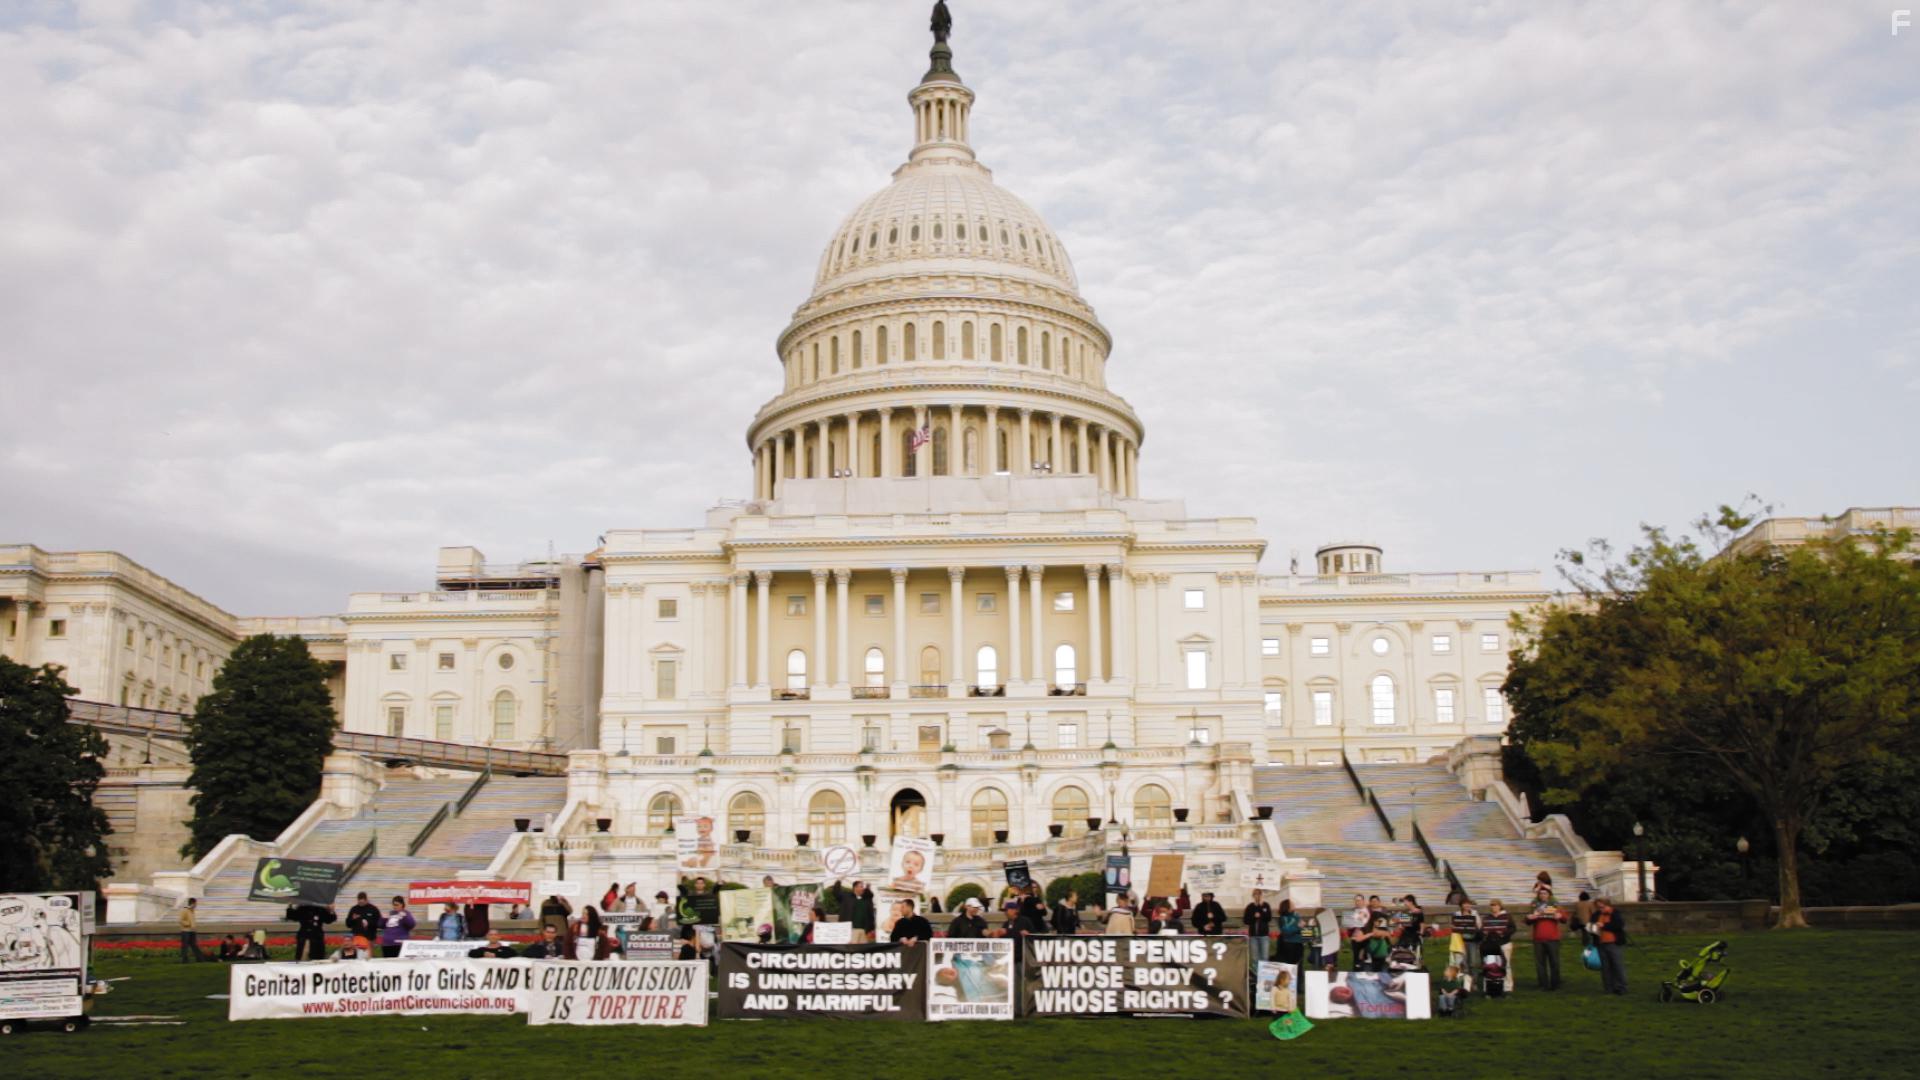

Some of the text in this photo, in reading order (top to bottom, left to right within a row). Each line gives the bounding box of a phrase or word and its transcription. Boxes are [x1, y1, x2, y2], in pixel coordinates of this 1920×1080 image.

[944, 942, 975, 952] PROTECT
[976, 942, 989, 952] OUR
[1034, 940, 1117, 963] WHOSE
[1129, 940, 1207, 963] PENIS
[746, 952, 902, 970] CIRCUMCISION
[245, 974, 306, 996] Genital
[312, 971, 402, 995] Protection
[408, 969, 432, 991] for
[437, 968, 476, 990] Girls
[480, 967, 520, 990] AND
[541, 966, 697, 991] CIRCUMCISION
[728, 973, 917, 990] IS UNNECESSARY
[1041, 965, 1124, 988] WHOSE
[1134, 968, 1194, 986] BODY
[303, 995, 515, 1014] www.StopInfantCircumcision.org
[550, 995, 687, 1020] IS TORTURE
[743, 994, 901, 1011] AND HARMFUL
[942, 1004, 974, 1014] TILATE
[1034, 990, 1118, 1013] WHOSE
[1124, 991, 1209, 1010] RIGHTS
